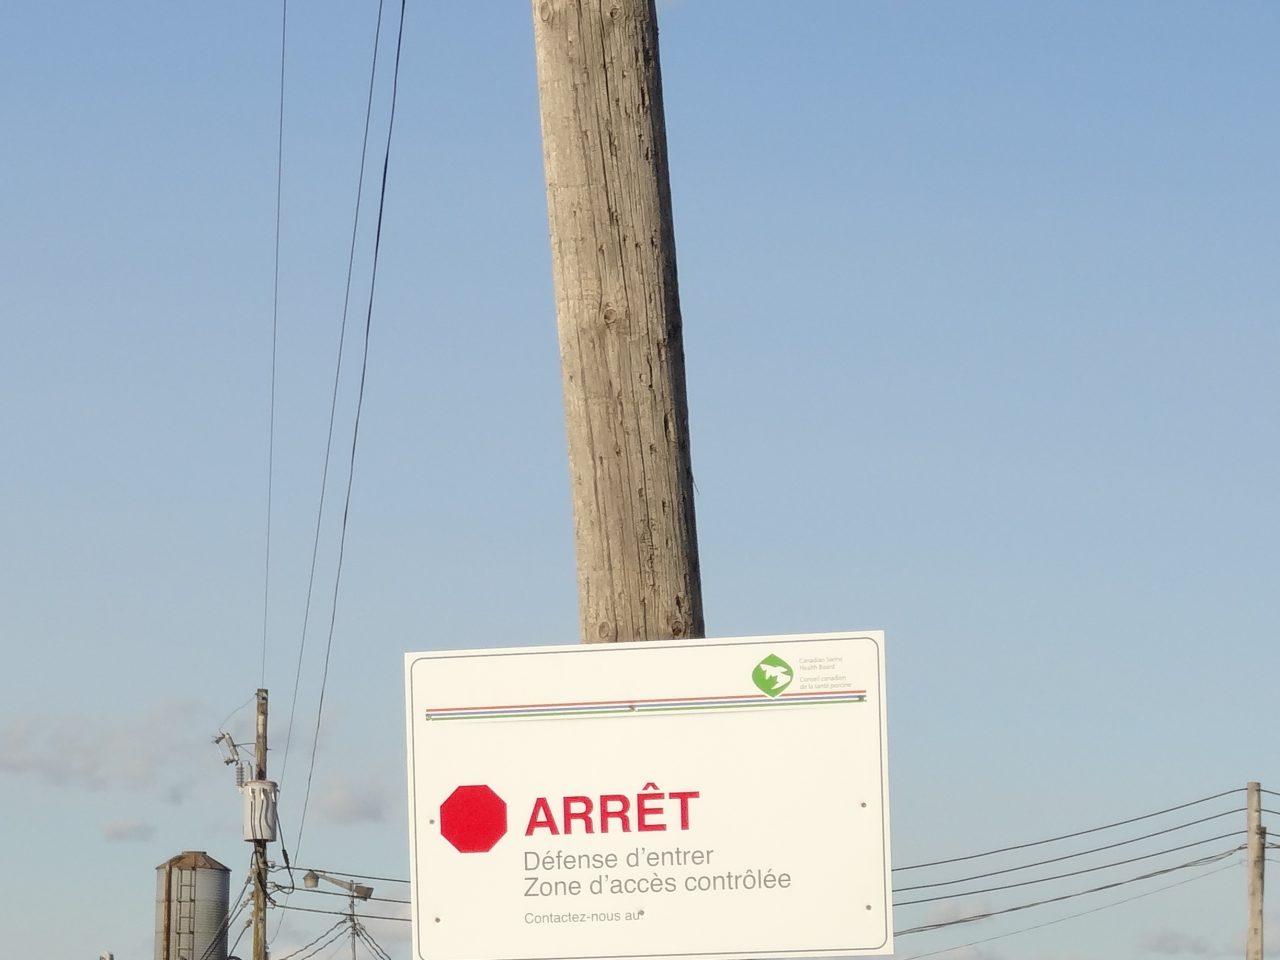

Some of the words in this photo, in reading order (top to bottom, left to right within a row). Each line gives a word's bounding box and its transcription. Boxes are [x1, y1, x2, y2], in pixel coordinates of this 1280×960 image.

[524, 782, 701, 837] ARRÊT
[524, 850, 618, 871] Défense
[626, 847, 714, 868] d'entrer
[524, 877, 582, 897] Zone
[590, 873, 677, 895] d'accès
[685, 868, 792, 892] contrôlée
[524, 912, 621, 924] Contactez-nous
